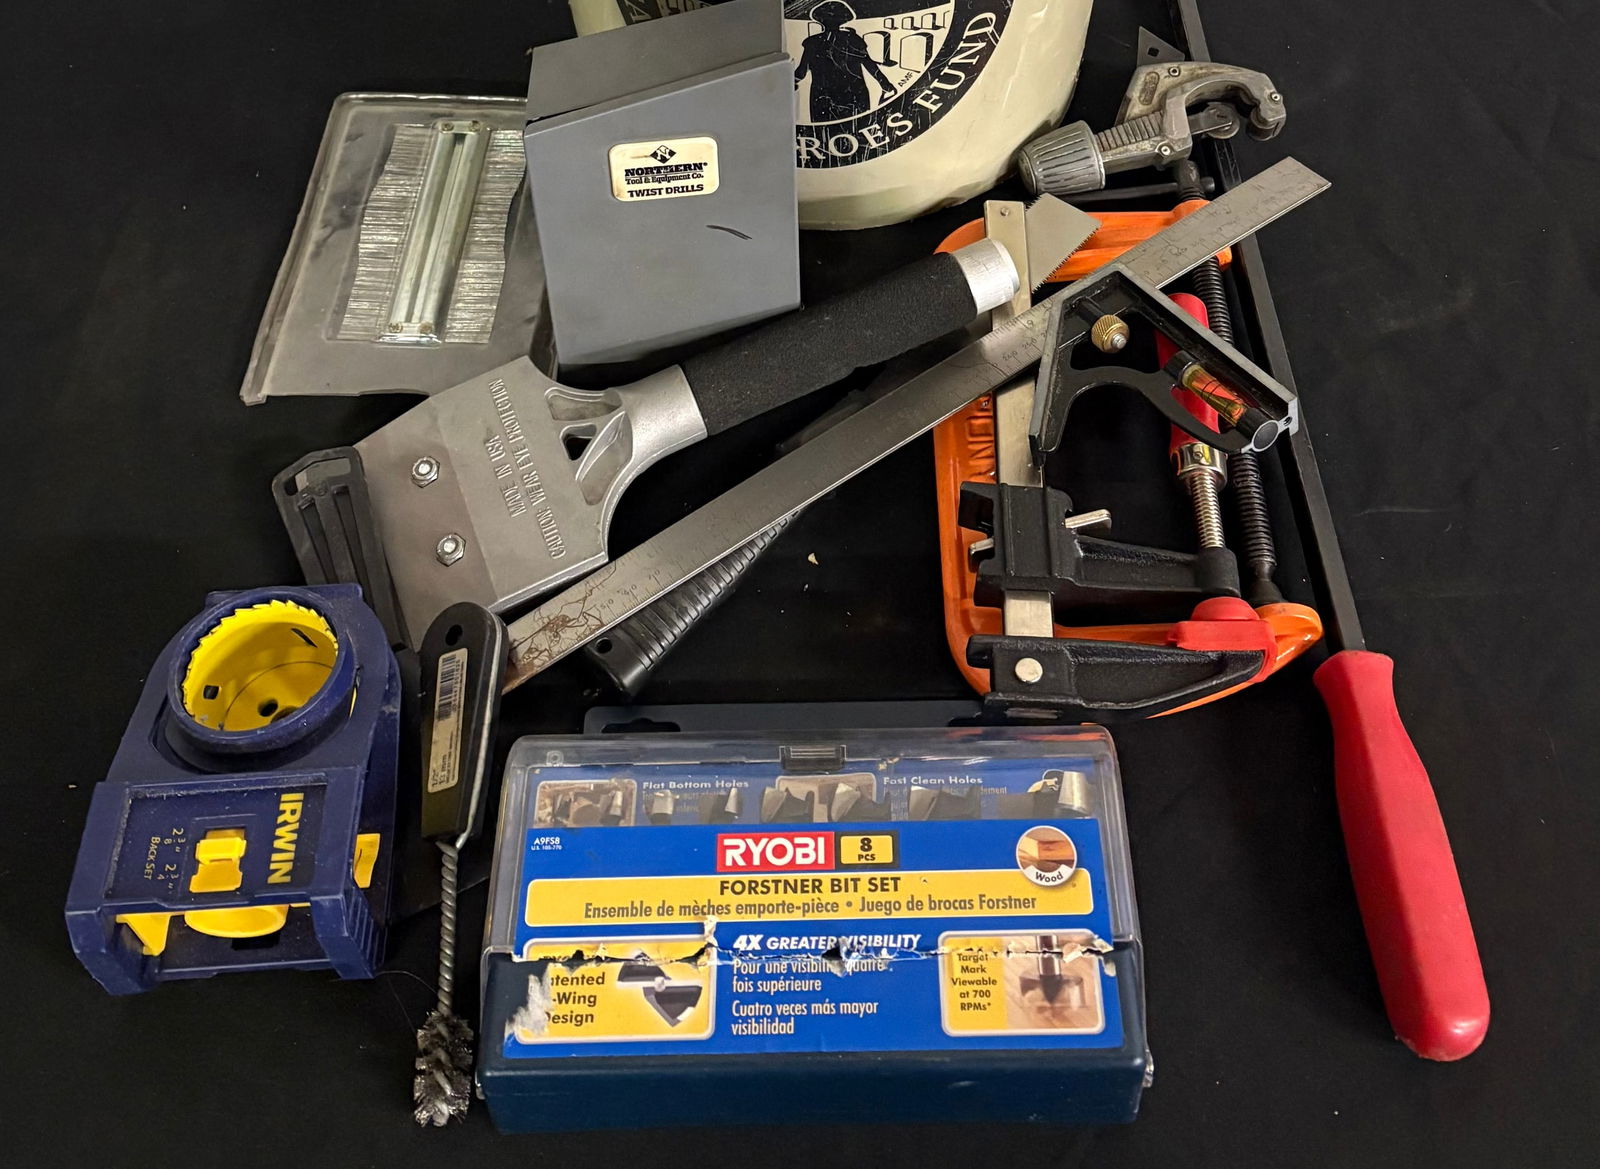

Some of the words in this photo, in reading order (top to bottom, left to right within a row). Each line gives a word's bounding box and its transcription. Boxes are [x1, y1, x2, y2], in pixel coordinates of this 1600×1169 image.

[798, 112, 914, 161] ROES
[914, 11, 999, 115] FUND
[625, 177, 643, 185] Tool
[651, 174, 691, 184] Equipment
[627, 187, 664, 198] TWIST
[666, 184, 704, 194] DRILLS
[489, 379, 524, 444] PROTECTION
[486, 434, 506, 461] USA
[514, 445, 533, 471] EYE
[495, 464, 512, 479] IN
[523, 470, 546, 506] WEAR
[500, 481, 527, 518] MADE
[643, 781, 665, 789] Flat
[669, 781, 711, 789] Bottom
[715, 779, 749, 788] Holes
[883, 776, 907, 785] Fast
[911, 776, 945, 785] Clean
[949, 775, 984, 784] Holes
[267, 793, 304, 884] IRWIN
[860, 838, 872, 852] 8
[723, 837, 825, 866] RYOBI
[1035, 871, 1064, 883] Wood
[720, 878, 823, 895] FORSTNER
[830, 877, 860, 893] BIT
[868, 877, 901, 892] SET
[584, 901, 652, 919] Ensemble
[657, 900, 674, 916] de
[680, 900, 731, 916] mèches
[736, 897, 839, 916] emporte-pièce
[859, 897, 901, 915] Juego
[906, 896, 923, 911] de
[928, 895, 974, 911] brocas
[979, 894, 1036, 910] Forstner
[733, 935, 764, 951] 4X
[766, 936, 838, 950] GREATER
[957, 953, 988, 963] Target
[733, 959, 760, 974] Pour
[765, 961, 788, 974] une
[960, 965, 987, 973] Mark
[550, 971, 606, 986] tented
[733, 976, 754, 993] fois
[757, 976, 822, 995] supérieure
[951, 977, 997, 986] Viewable
[959, 991, 969, 999] at
[973, 990, 991, 998] 700
[732, 1001, 773, 1017] Cuatro
[775, 1003, 808, 1017] veces
[811, 1001, 836, 1016] más
[840, 1002, 879, 1019] mayor
[732, 1017, 795, 1035] visibilidad
